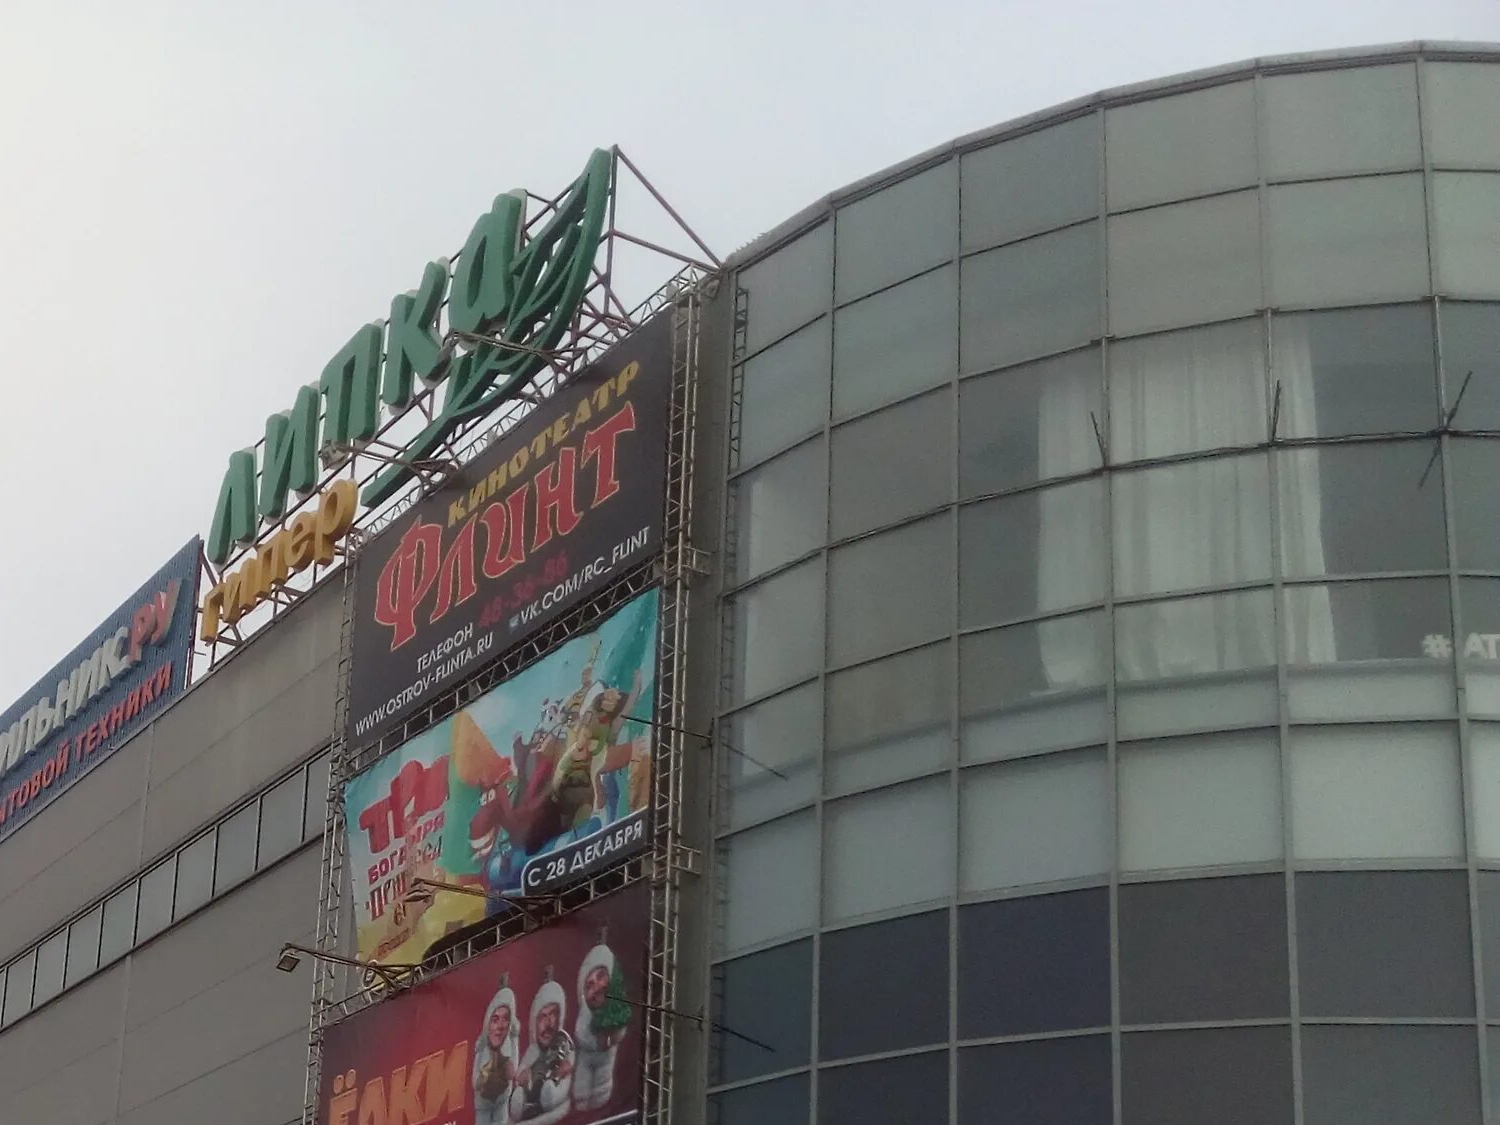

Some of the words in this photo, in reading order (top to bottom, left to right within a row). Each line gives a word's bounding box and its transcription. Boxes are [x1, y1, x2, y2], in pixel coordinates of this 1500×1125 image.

[447, 361, 640, 528] КИНОТЕАТР
[521, 526, 650, 626] VK.COM/RC_FLINT
[355, 633, 493, 736] WWW.OSTROV-FLINTA.RU
[416, 623, 474, 672] ТЕЛЕФОН
[75, 661, 173, 762] ТЕХНИКИ
[528, 866, 542, 887] С
[546, 857, 567, 880] 28
[570, 819, 643, 875] ДЕКАБРЯ
